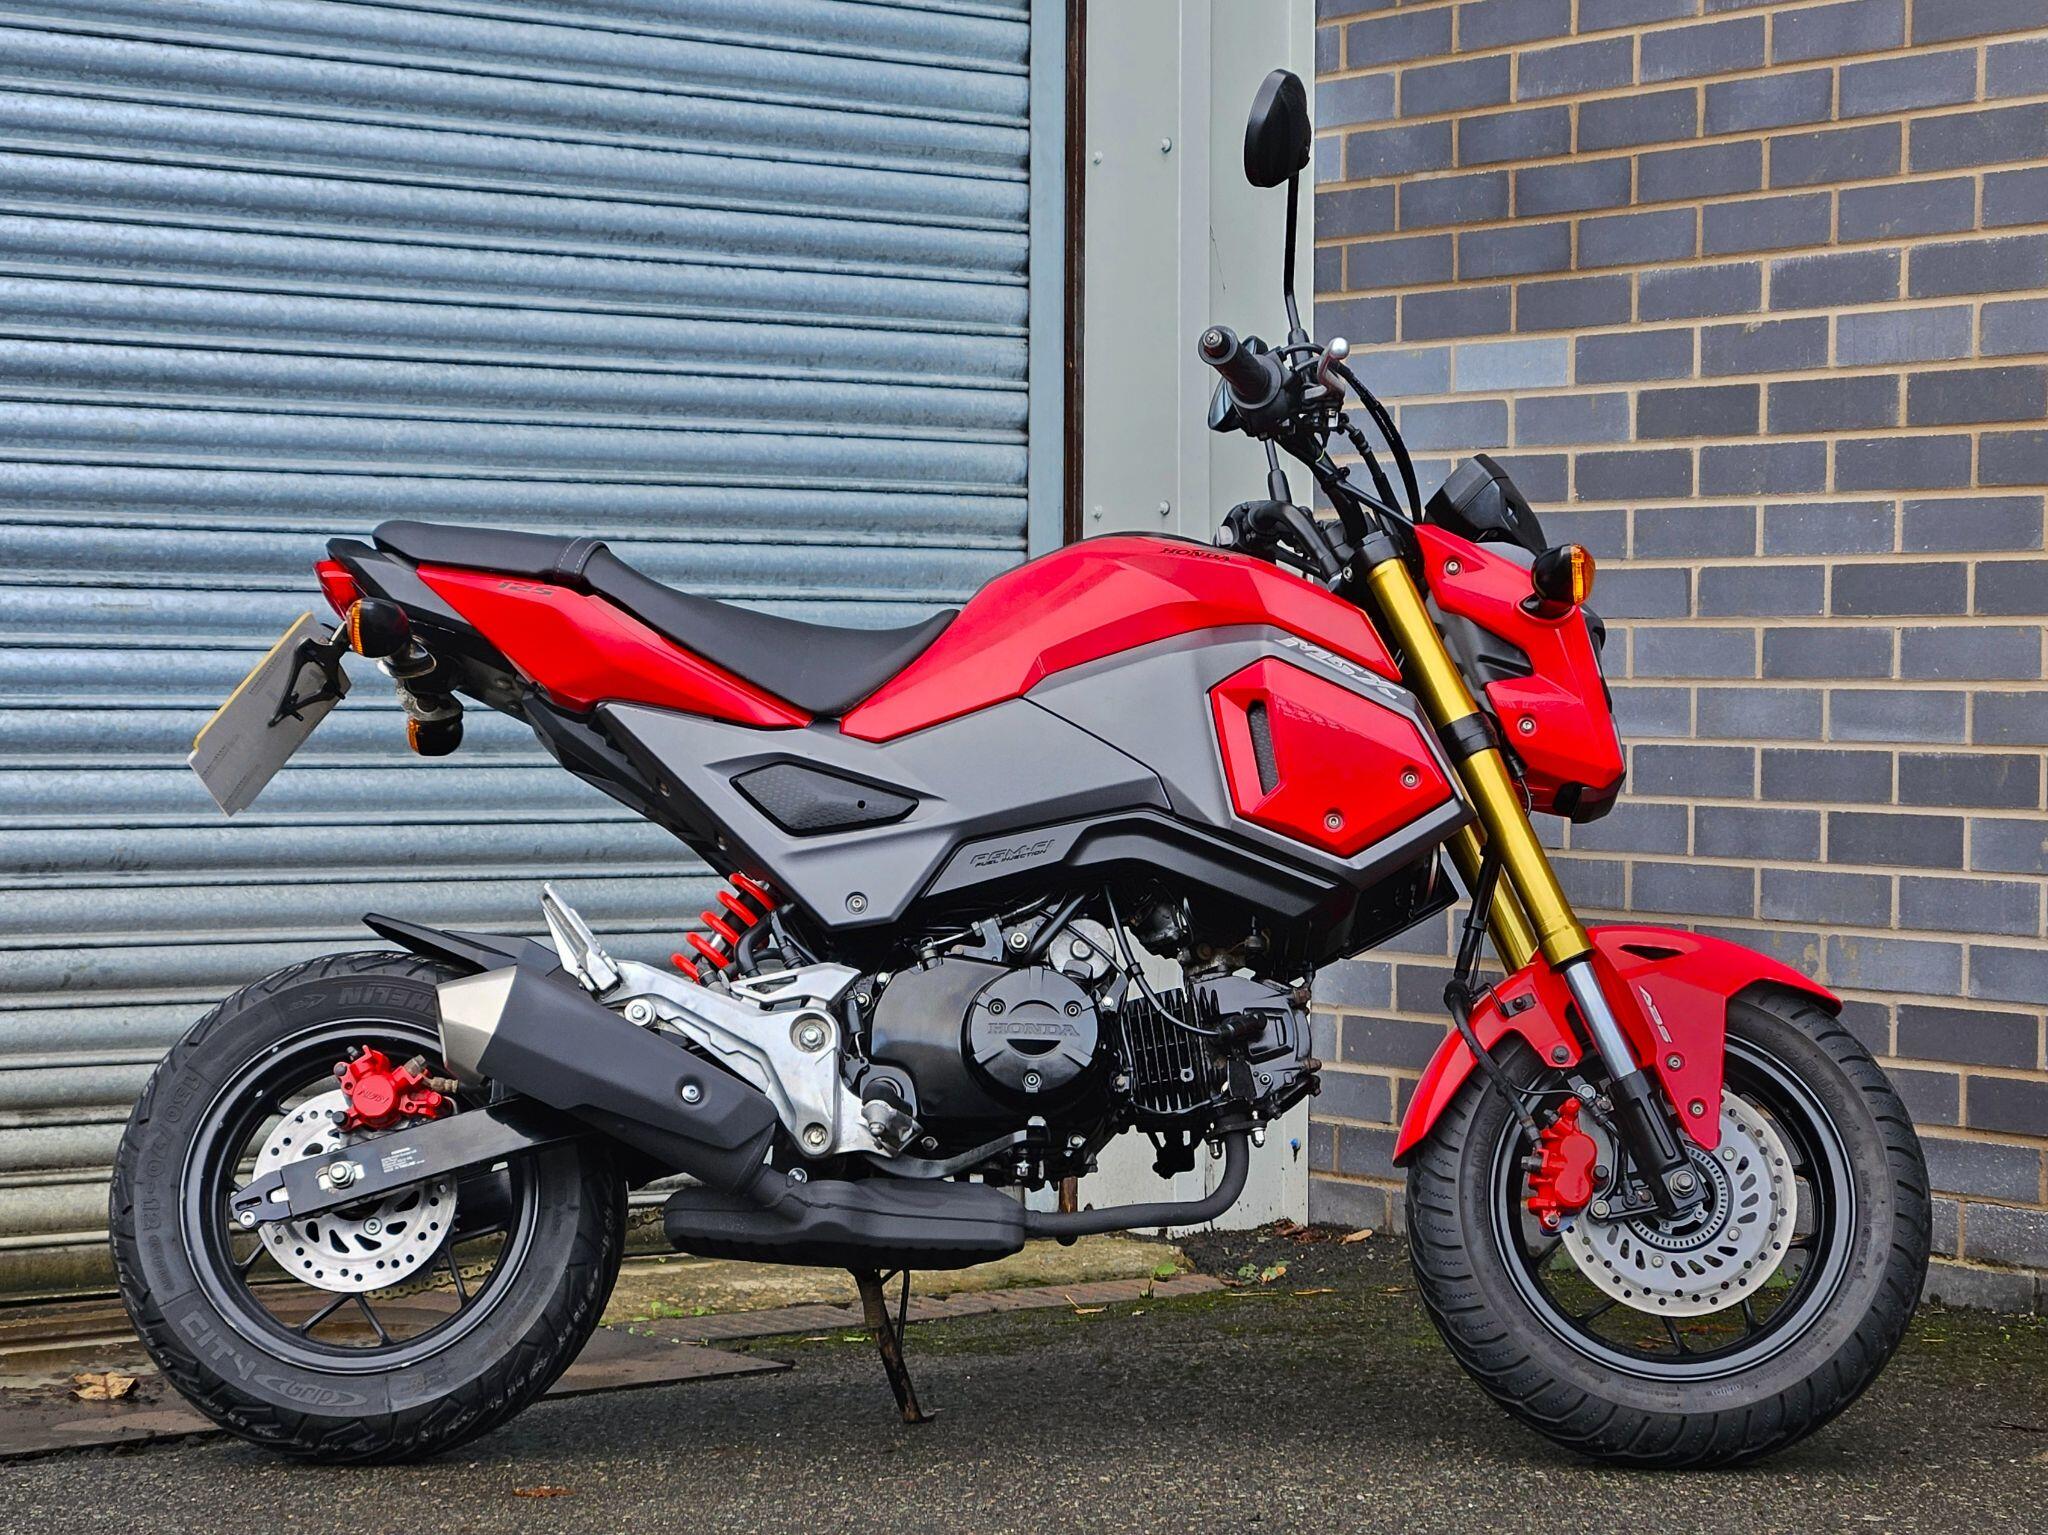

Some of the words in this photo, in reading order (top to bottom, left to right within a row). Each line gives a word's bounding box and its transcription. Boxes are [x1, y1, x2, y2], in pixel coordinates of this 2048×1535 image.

[1160, 547, 1231, 562] HONDA
[498, 581, 555, 596] 125
[1274, 636, 1406, 699] MSX
[975, 858, 999, 868] FUEL
[1000, 849, 1047, 864] INJECTION
[1638, 985, 1673, 1044] ABS
[987, 1022, 1080, 1037] HONDA
[180, 1310, 257, 1381] CITY
